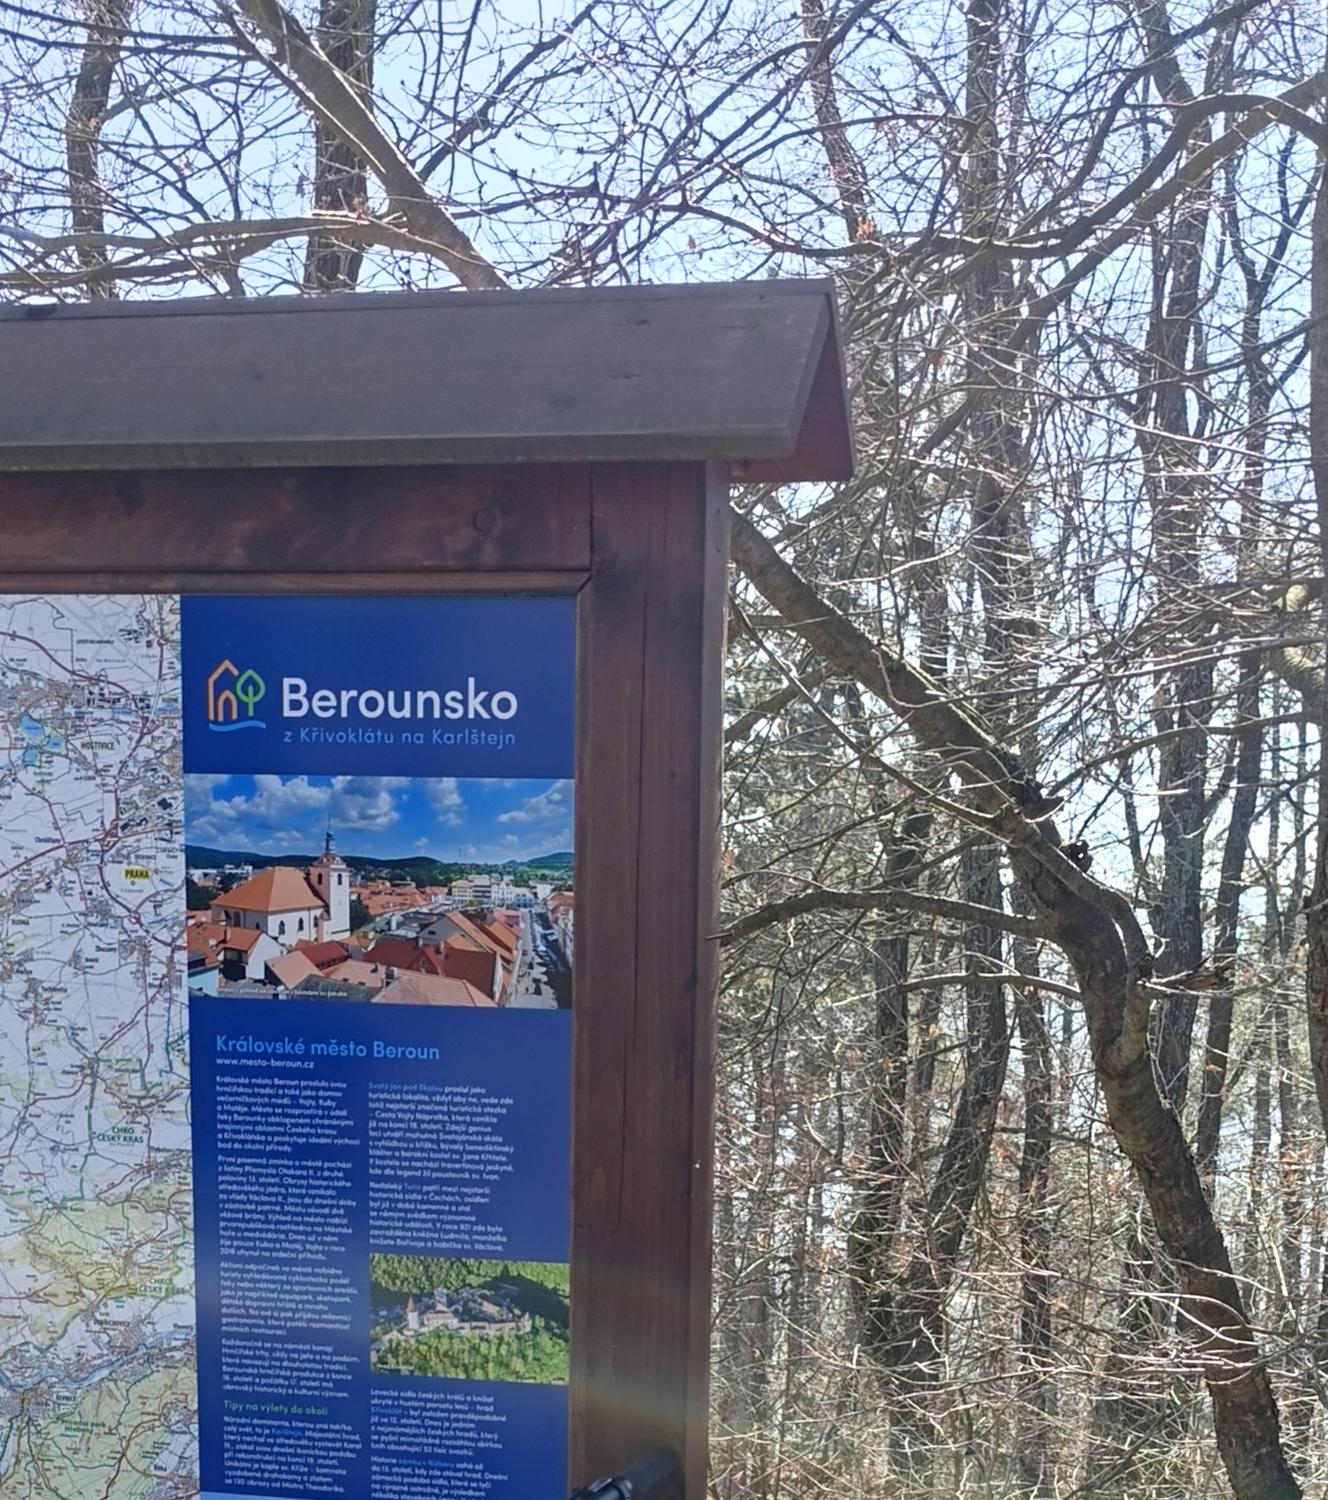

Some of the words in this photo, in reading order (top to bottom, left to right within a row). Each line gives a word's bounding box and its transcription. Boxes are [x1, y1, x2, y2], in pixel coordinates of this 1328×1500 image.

[282, 677, 518, 720] Berounsko
[284, 731, 292, 743] z
[300, 727, 394, 744] Křivoklátu
[402, 732, 424, 744] na
[432, 728, 515, 749] Karlštejn
[125, 869, 149, 880] PRAHA
[217, 1035, 305, 1054] Královské
[311, 1039, 367, 1057] město
[373, 1041, 439, 1060] Beroun
[216, 1057, 314, 1068] www.mesto-beroun.cz
[224, 1400, 243, 1412] Tipy
[246, 1404, 258, 1412] na
[261, 1402, 288, 1416] výlety
[291, 1405, 303, 1414] do
[305, 1406, 328, 1416] okolí
